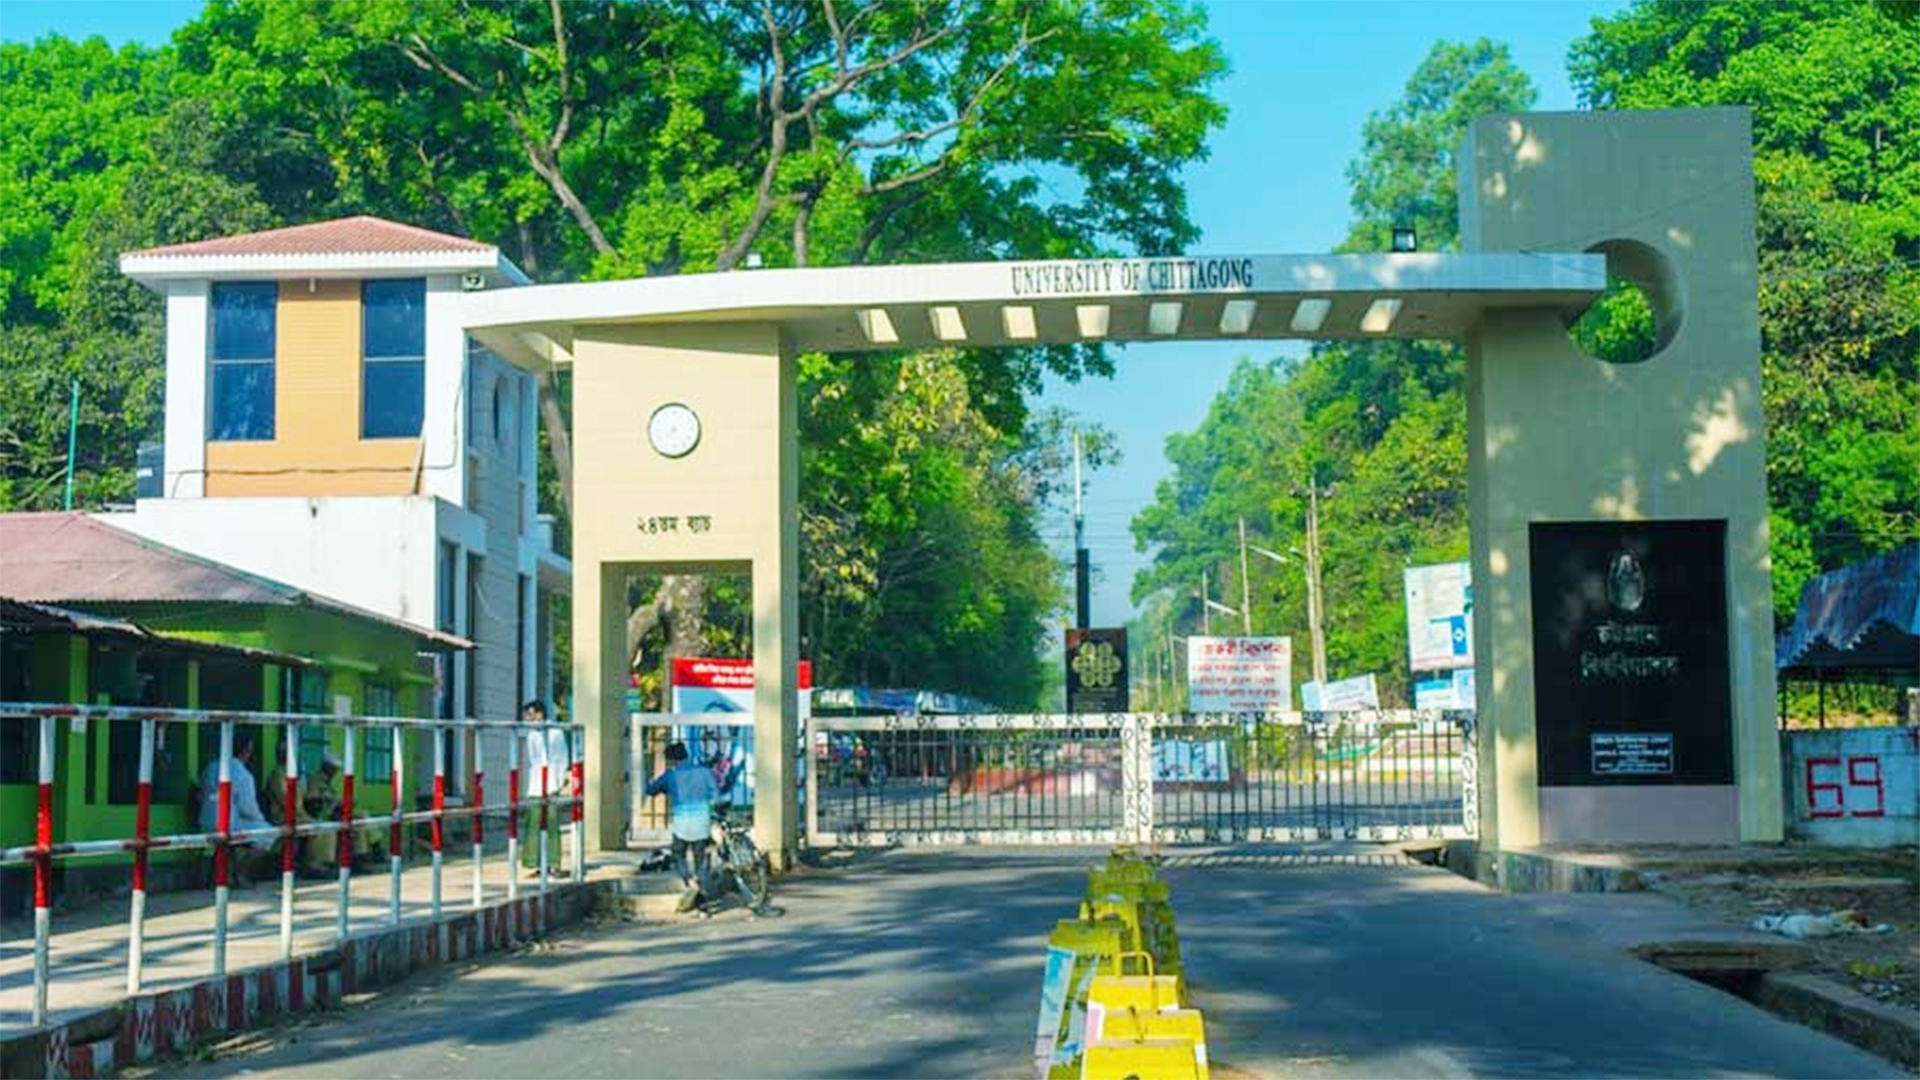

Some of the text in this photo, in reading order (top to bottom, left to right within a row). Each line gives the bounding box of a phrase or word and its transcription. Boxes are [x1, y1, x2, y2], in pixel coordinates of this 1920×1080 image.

[1011, 258, 1253, 294] UNIVERSITY OF CHITTAGONG
[1807, 757, 1884, 818] 69
